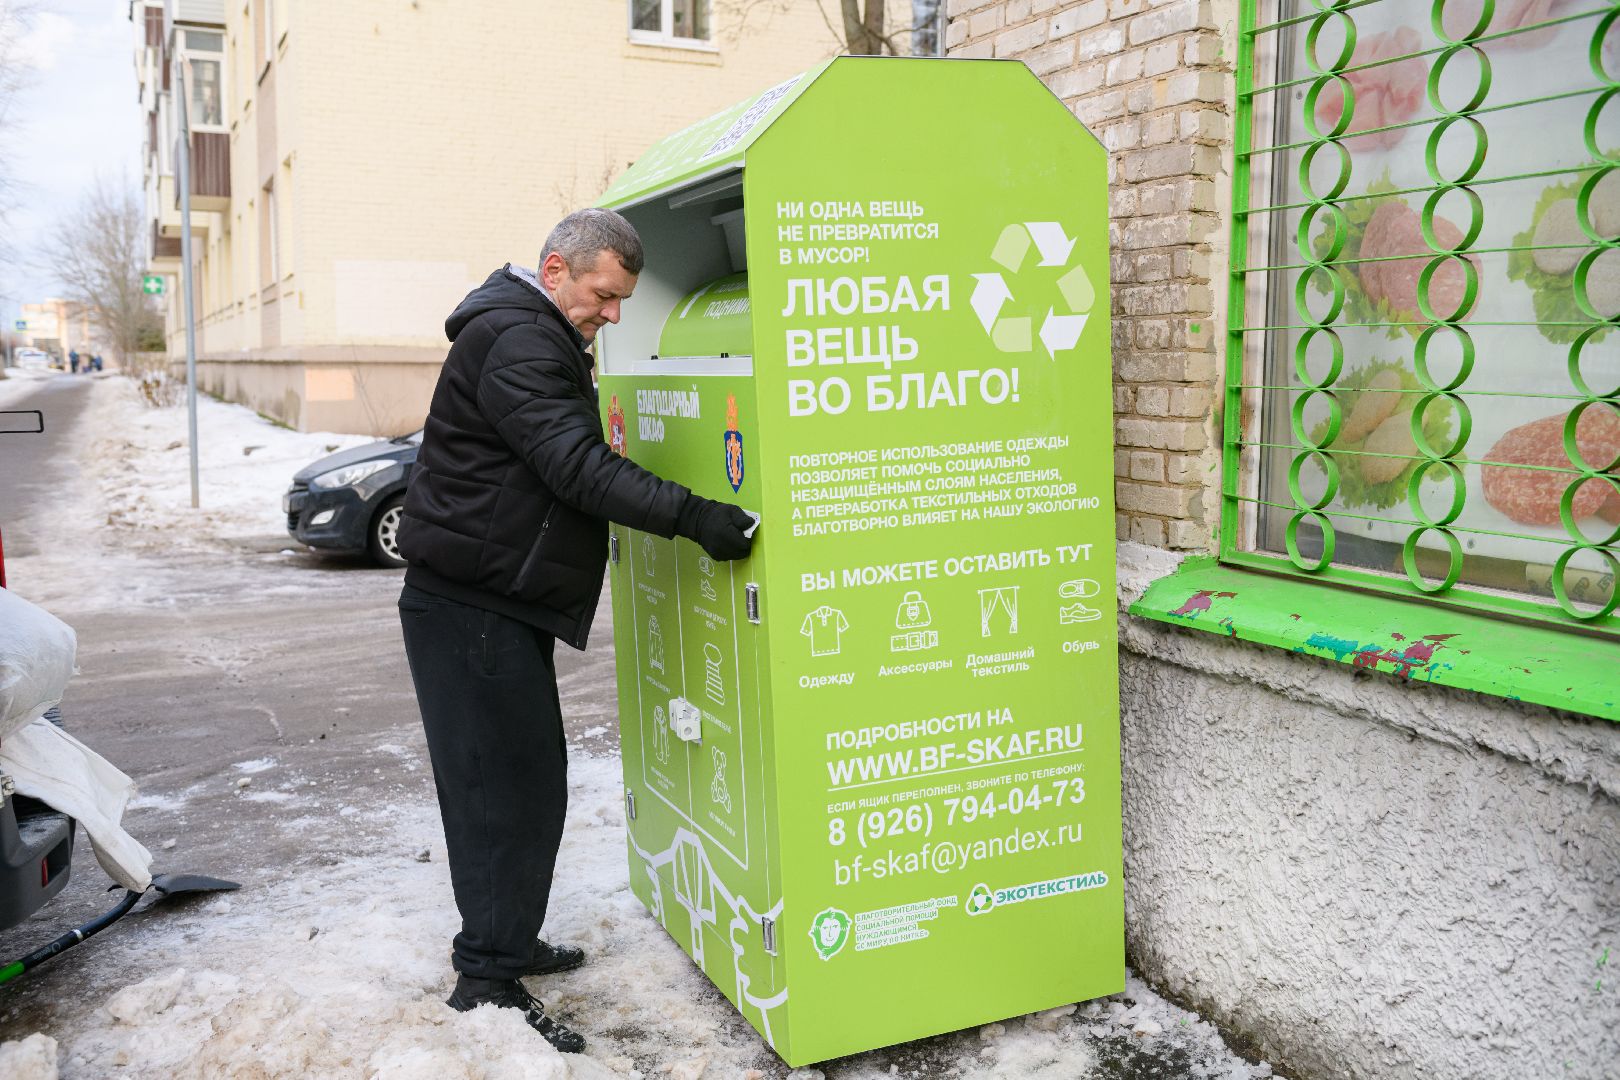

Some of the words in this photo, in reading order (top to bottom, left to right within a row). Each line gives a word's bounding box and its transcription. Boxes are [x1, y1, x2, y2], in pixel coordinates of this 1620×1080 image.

[777, 201, 804, 219] НИ
[809, 201, 864, 221] ОДНА
[869, 200, 924, 220] ВЕЩЬ
[778, 224, 804, 242] НЕ
[809, 223, 939, 241] ПРЕВРАТИТСЯ
[779, 248, 792, 265] В
[797, 246, 869, 264] МУСОР!
[782, 274, 950, 317] ЛЮБАЯ
[785, 325, 919, 370] ВЕЩЬ
[637, 384, 700, 419] БЛАГОДАРНЫЙ
[788, 376, 851, 417] ВО
[866, 368, 1020, 412] БЛАГО!
[638, 416, 664, 443] ШКАФ
[789, 449, 878, 468] ПОВТОРНОЕ
[881, 440, 1003, 461] ИСПОЛЬЗОВАНИЕ
[1006, 436, 1069, 453] ОДЕЖДЫ
[790, 466, 877, 485] ПОЗВОЛЯЕТ
[882, 462, 942, 477] ПОМОЧЬ
[945, 454, 1030, 472] СОЦИАЛЬНО
[791, 480, 921, 502] НЕЗАЩИЩЁННЫМ
[925, 475, 975, 491] СЛОЯМ
[979, 468, 1062, 486] НАСЕЛЕНИЯ,
[792, 507, 802, 520] А
[806, 498, 908, 518] ПЕРЕРАБОТКА
[911, 489, 1011, 508] ТЕКСТИЛЬНЫХ
[1015, 483, 1077, 499] ОТХОДОВ
[793, 515, 899, 536] БЛАГОТВОРНО
[902, 510, 957, 526] ВЛИЯЕТ
[961, 508, 980, 520] НА
[983, 504, 1023, 519] НАШУ
[1027, 496, 1099, 514] ЭКОЛОГИЮ
[801, 570, 835, 592] ВЫ
[842, 560, 938, 587] МОЖЕТЕ
[944, 549, 1051, 576] ОСТАВИТЬ
[1056, 544, 1093, 563] ТУТ
[966, 647, 1034, 668] Домашний
[1062, 640, 1100, 654] Обувь
[799, 672, 855, 689] Одежду
[878, 659, 952, 676] Аксессуары
[972, 662, 1030, 677] текстиль
[827, 712, 981, 751] ПОДРОБНОСТИ
[987, 708, 1014, 727] НА
[827, 724, 1082, 785] WWW.BF-SKAF.RU
[827, 800, 855, 814] ЕСЛИ
[858, 794, 889, 809] ЯЩИК
[892, 783, 963, 803] ПЕРЕПОЛНЕН,
[966, 774, 1012, 791] ЗВОНИТЕ
[1014, 772, 1029, 783] ПО
[1031, 763, 1085, 780] ТЕЛЕФОНУ:
[829, 818, 846, 846] 8
[857, 802, 933, 848] (926)
[944, 777, 1085, 825] 794-04-73
[835, 824, 1082, 885] bf-skaf@yandex.ru
[996, 873, 1106, 903] ЭКОТЕКСТИЛЬ
